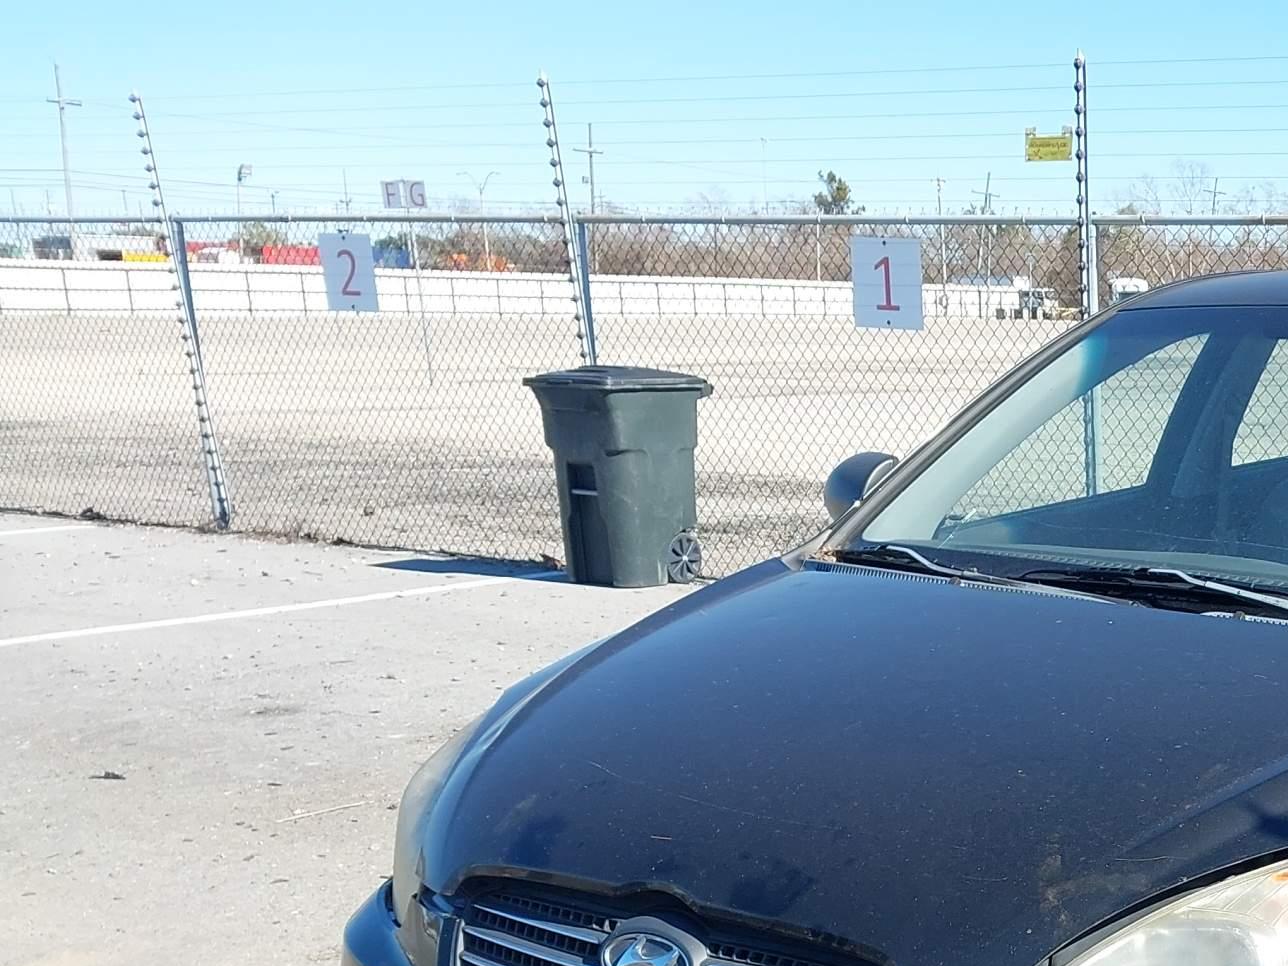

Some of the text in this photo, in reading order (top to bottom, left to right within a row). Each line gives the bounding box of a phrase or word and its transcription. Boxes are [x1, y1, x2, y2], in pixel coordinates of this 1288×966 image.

[384, 182, 397, 208] F
[409, 182, 425, 208] G
[336, 249, 362, 296] 2
[873, 256, 900, 311] 1
